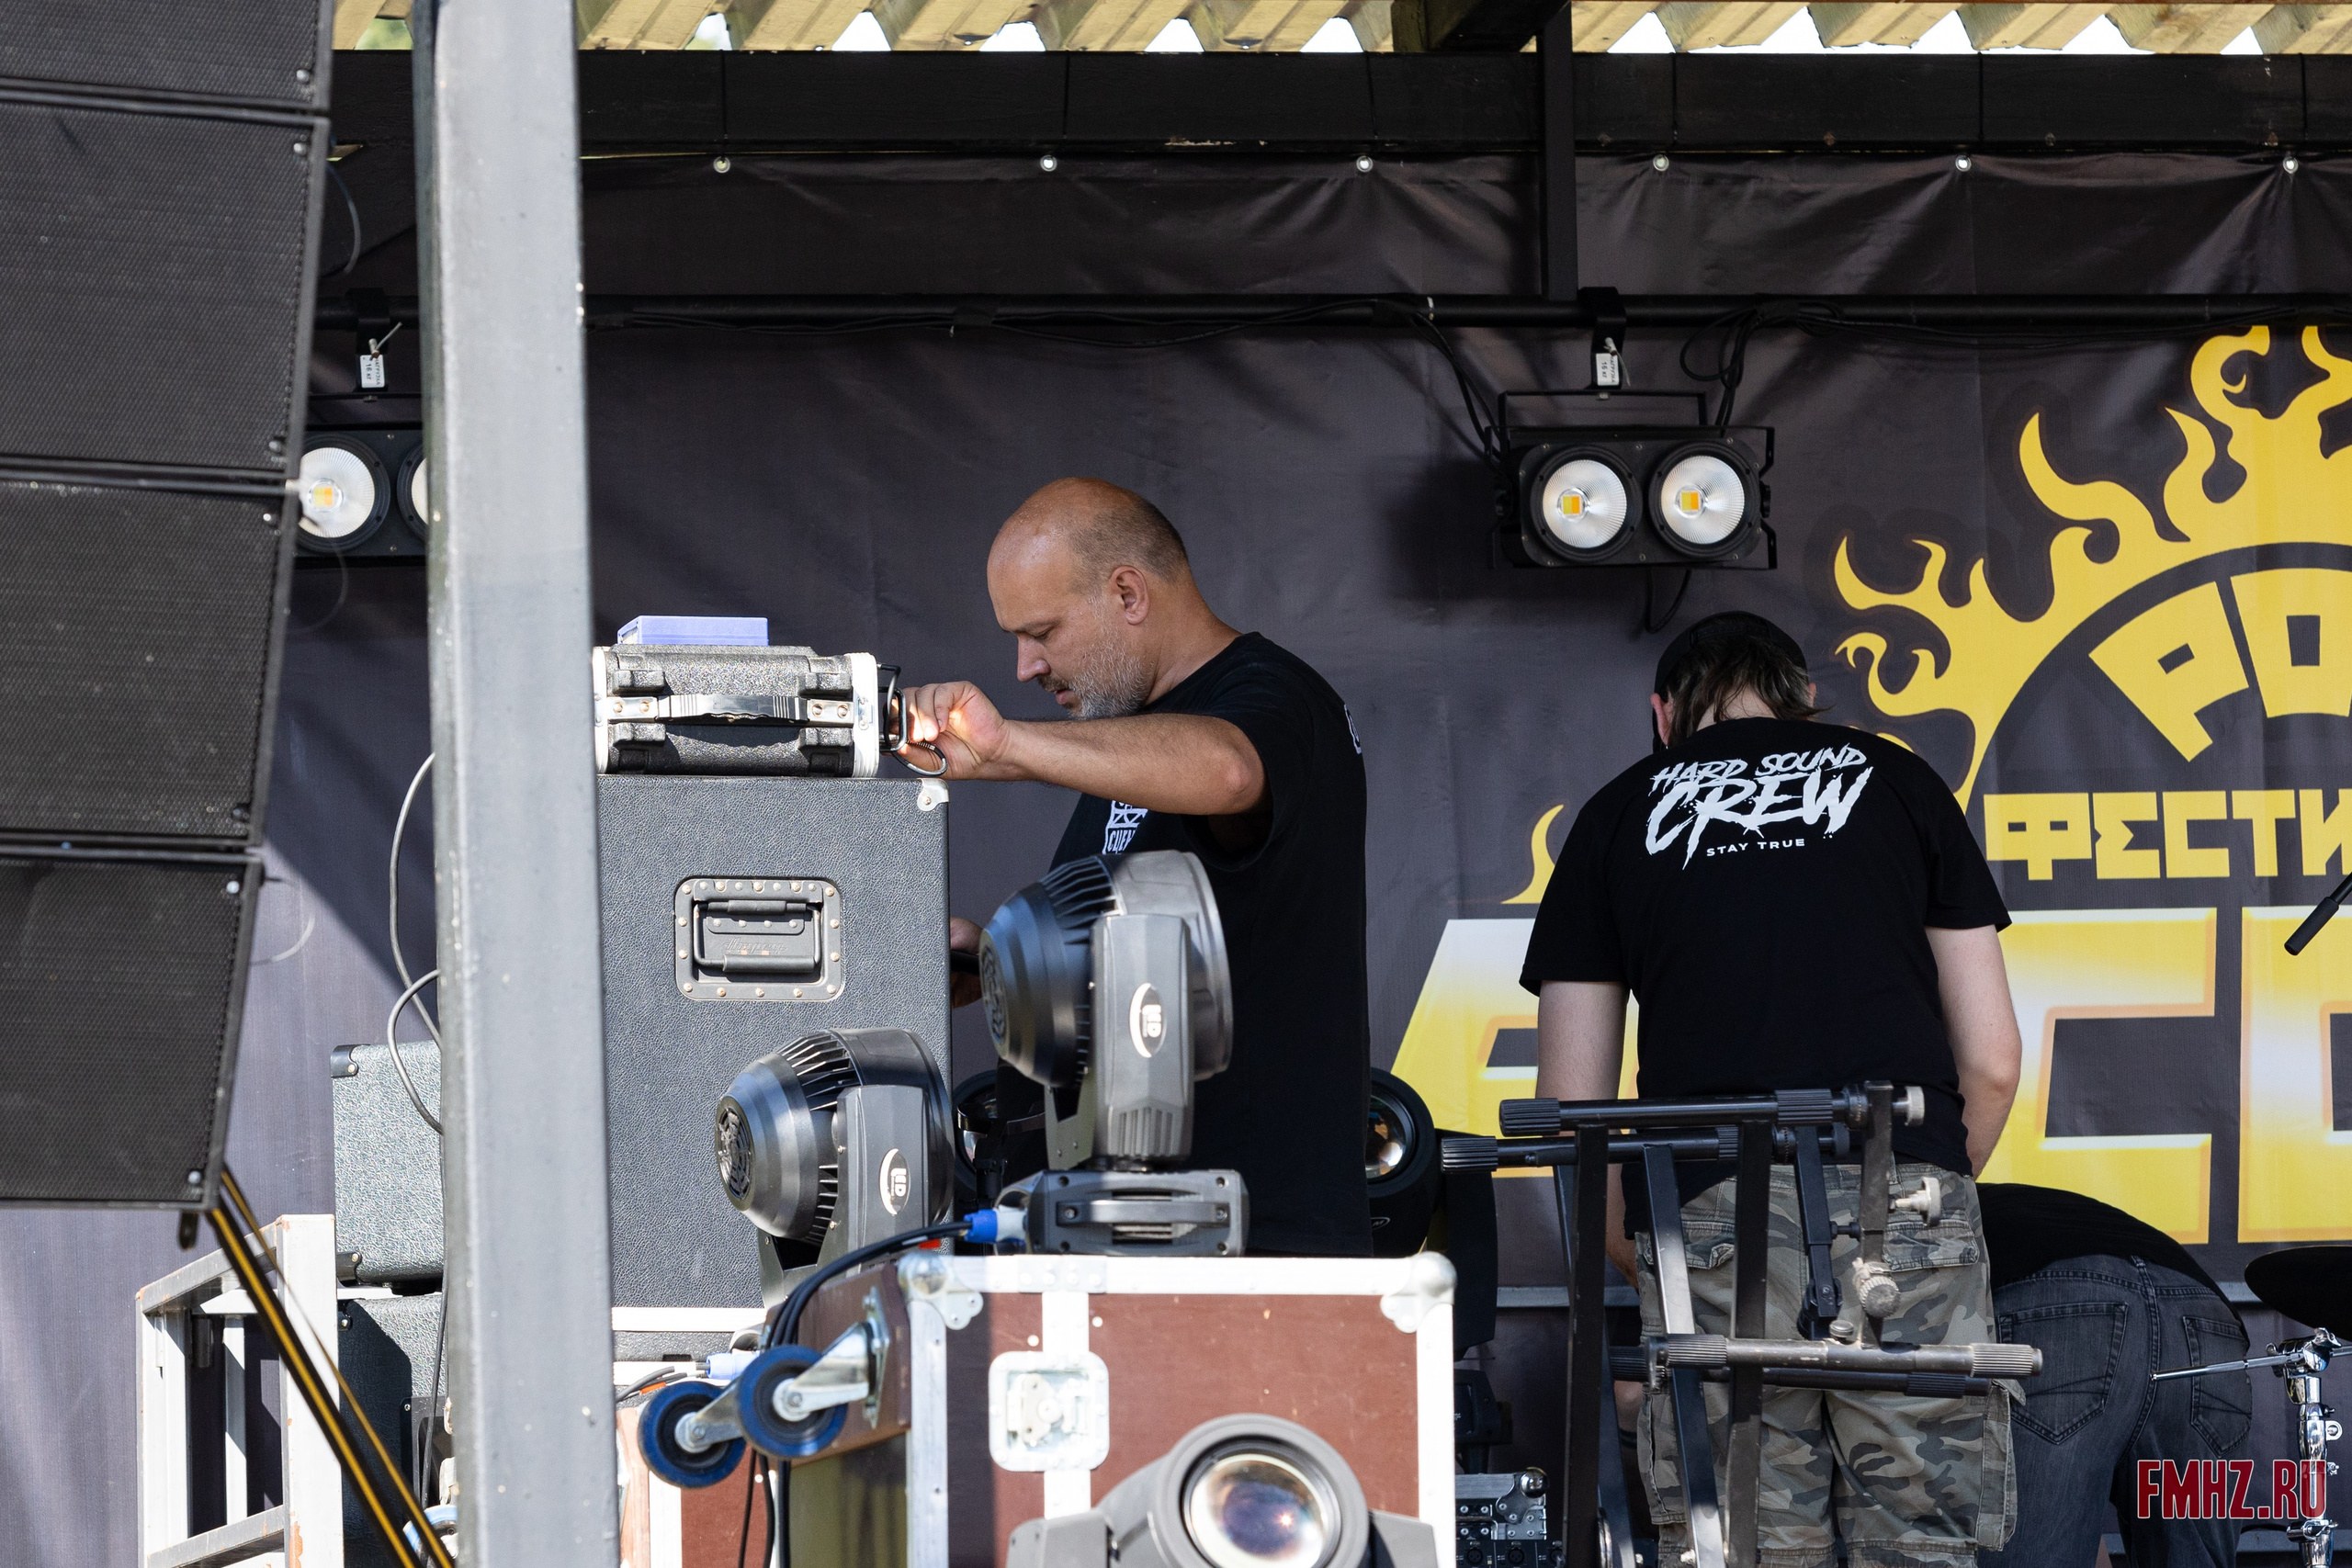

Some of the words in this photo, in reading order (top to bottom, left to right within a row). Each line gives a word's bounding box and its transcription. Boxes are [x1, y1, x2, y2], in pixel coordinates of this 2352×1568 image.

[1649, 759, 1747, 795] HARD
[1756, 743, 1867, 777] SOUND
[1645, 766, 1873, 870] CREW
[1706, 841, 1749, 856] STAY
[1758, 838, 1805, 850] TRUE
